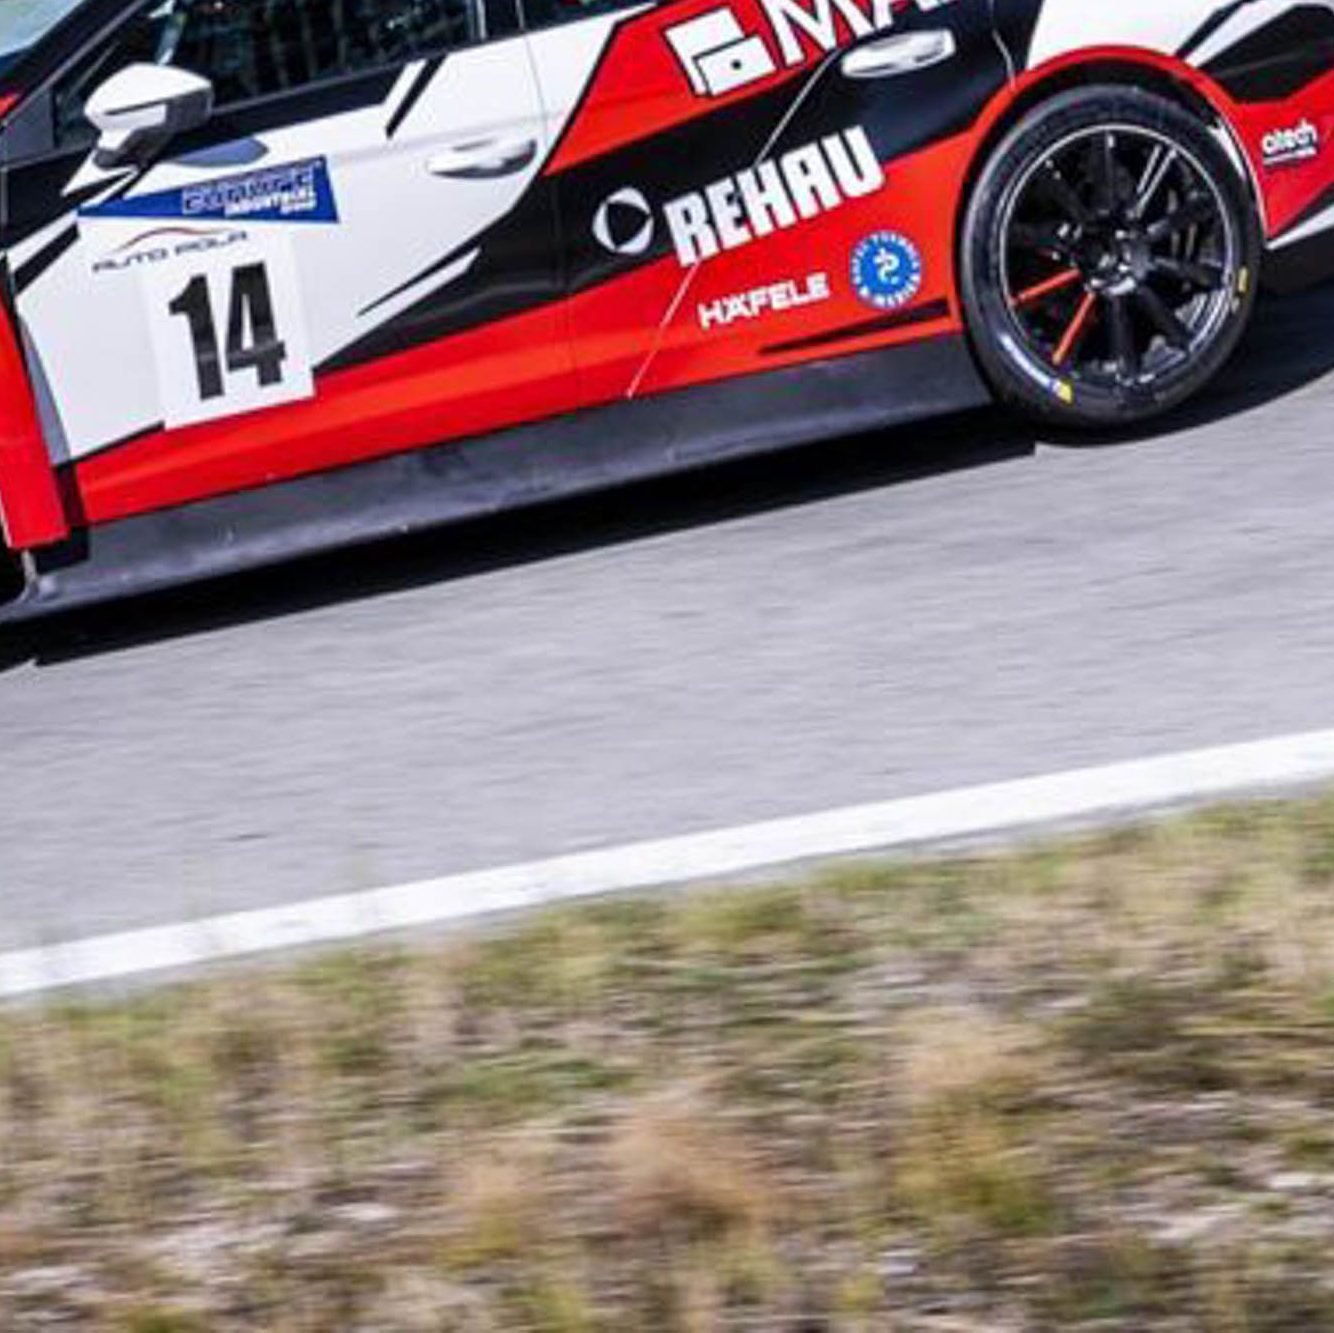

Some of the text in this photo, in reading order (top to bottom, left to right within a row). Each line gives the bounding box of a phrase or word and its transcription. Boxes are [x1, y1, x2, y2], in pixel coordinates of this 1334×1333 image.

[92, 229, 248, 273] AUTO POLA
[663, 124, 886, 266] REHAU
[168, 260, 288, 402] 14
